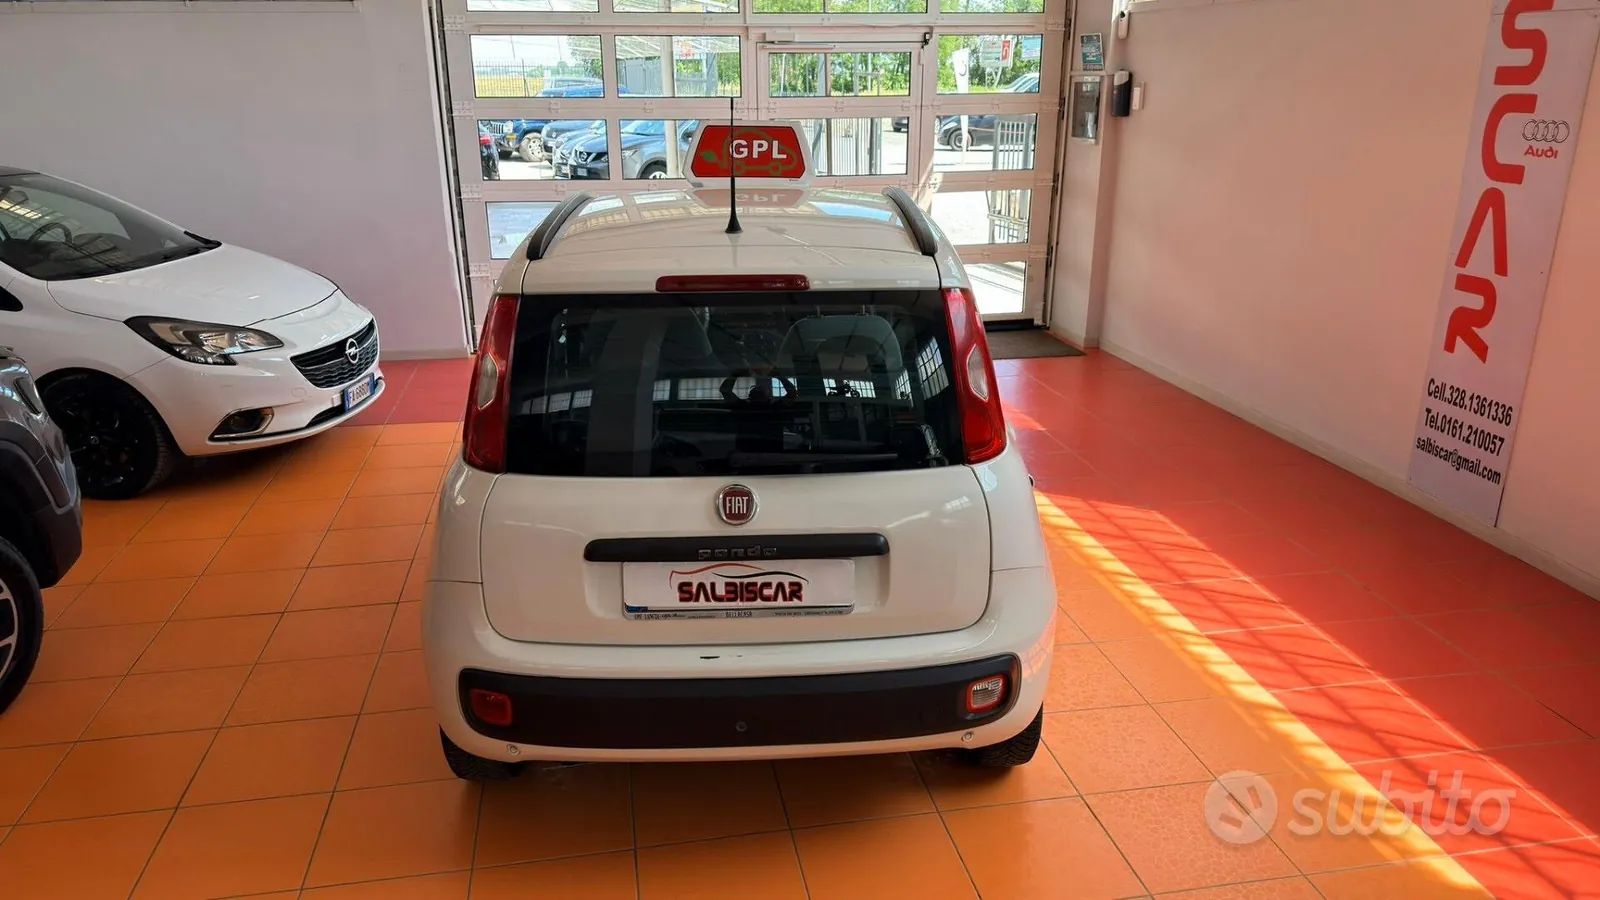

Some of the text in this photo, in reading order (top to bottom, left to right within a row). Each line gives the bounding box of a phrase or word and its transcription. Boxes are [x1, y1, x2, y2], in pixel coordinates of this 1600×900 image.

[729, 139, 787, 159] GPL
[1524, 144, 1559, 159] Audi
[1427, 377, 1514, 427] Cell.328.1361336
[1424, 407, 1506, 457] Tel.0161.210057
[1415, 436, 1502, 486] salbiscar@gmail.com
[726, 496, 749, 514] FIAT
[677, 581, 803, 603] SALBISCAR
